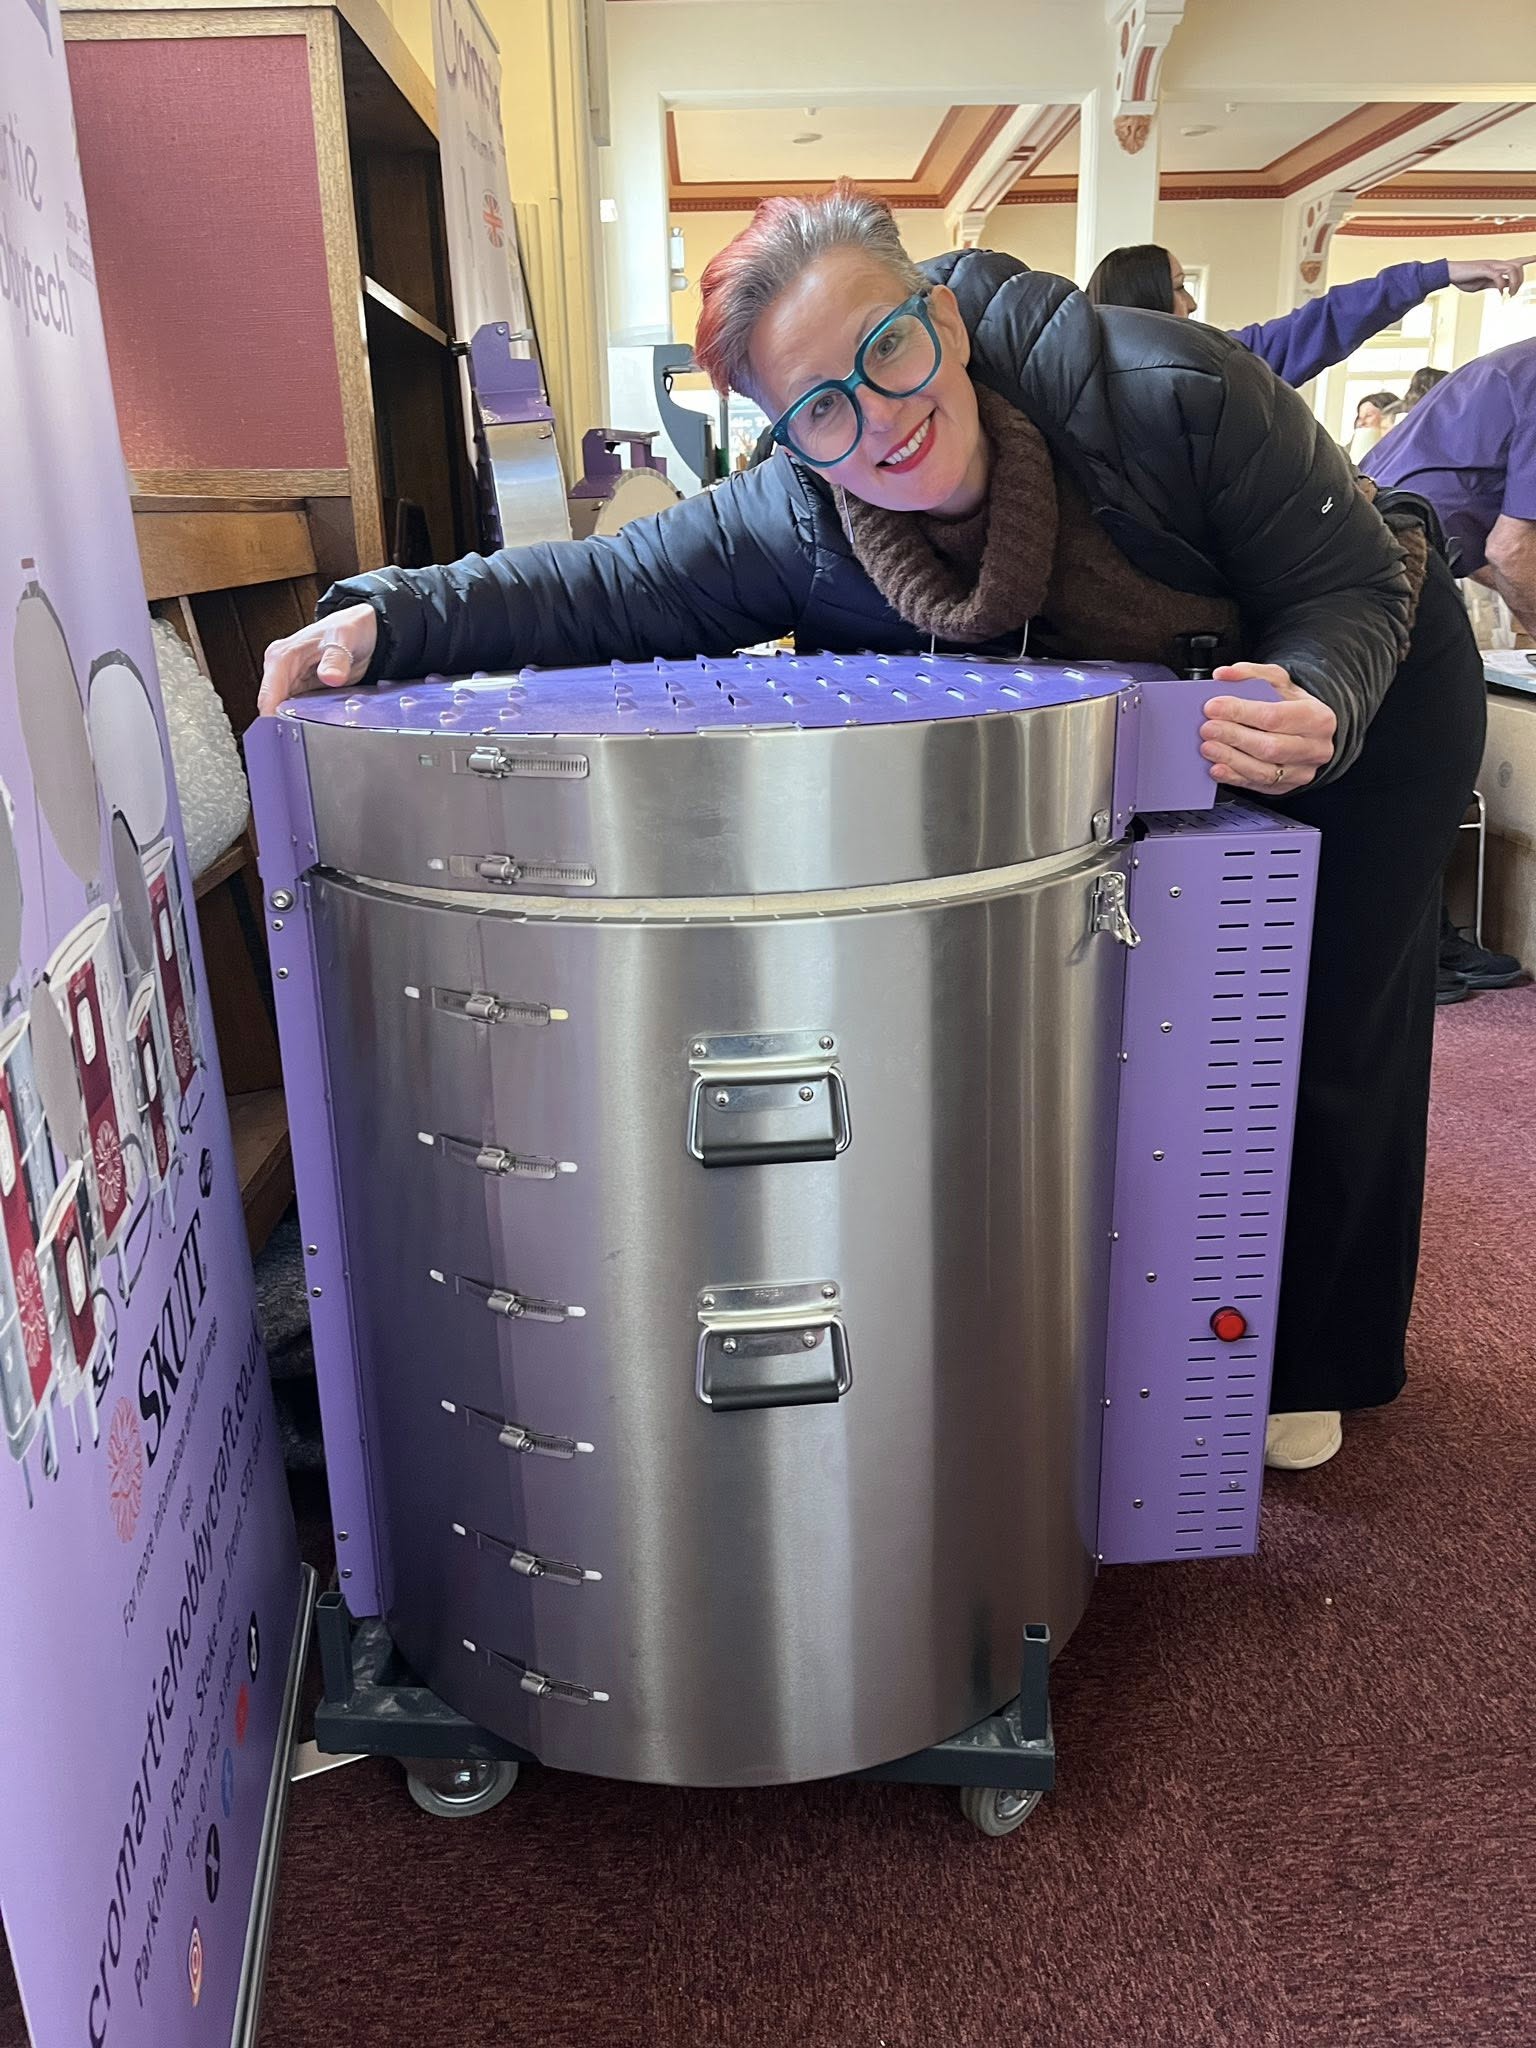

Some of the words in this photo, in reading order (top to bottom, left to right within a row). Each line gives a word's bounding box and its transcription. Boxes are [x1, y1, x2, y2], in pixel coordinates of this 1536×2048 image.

[138, 1207, 207, 1468] SKUTT
[135, 1815, 173, 2006] Parkhall
[171, 1715, 198, 1825] Road,
[196, 1623, 217, 1716] Stoke
[186, 1814, 201, 1872] Tel:
